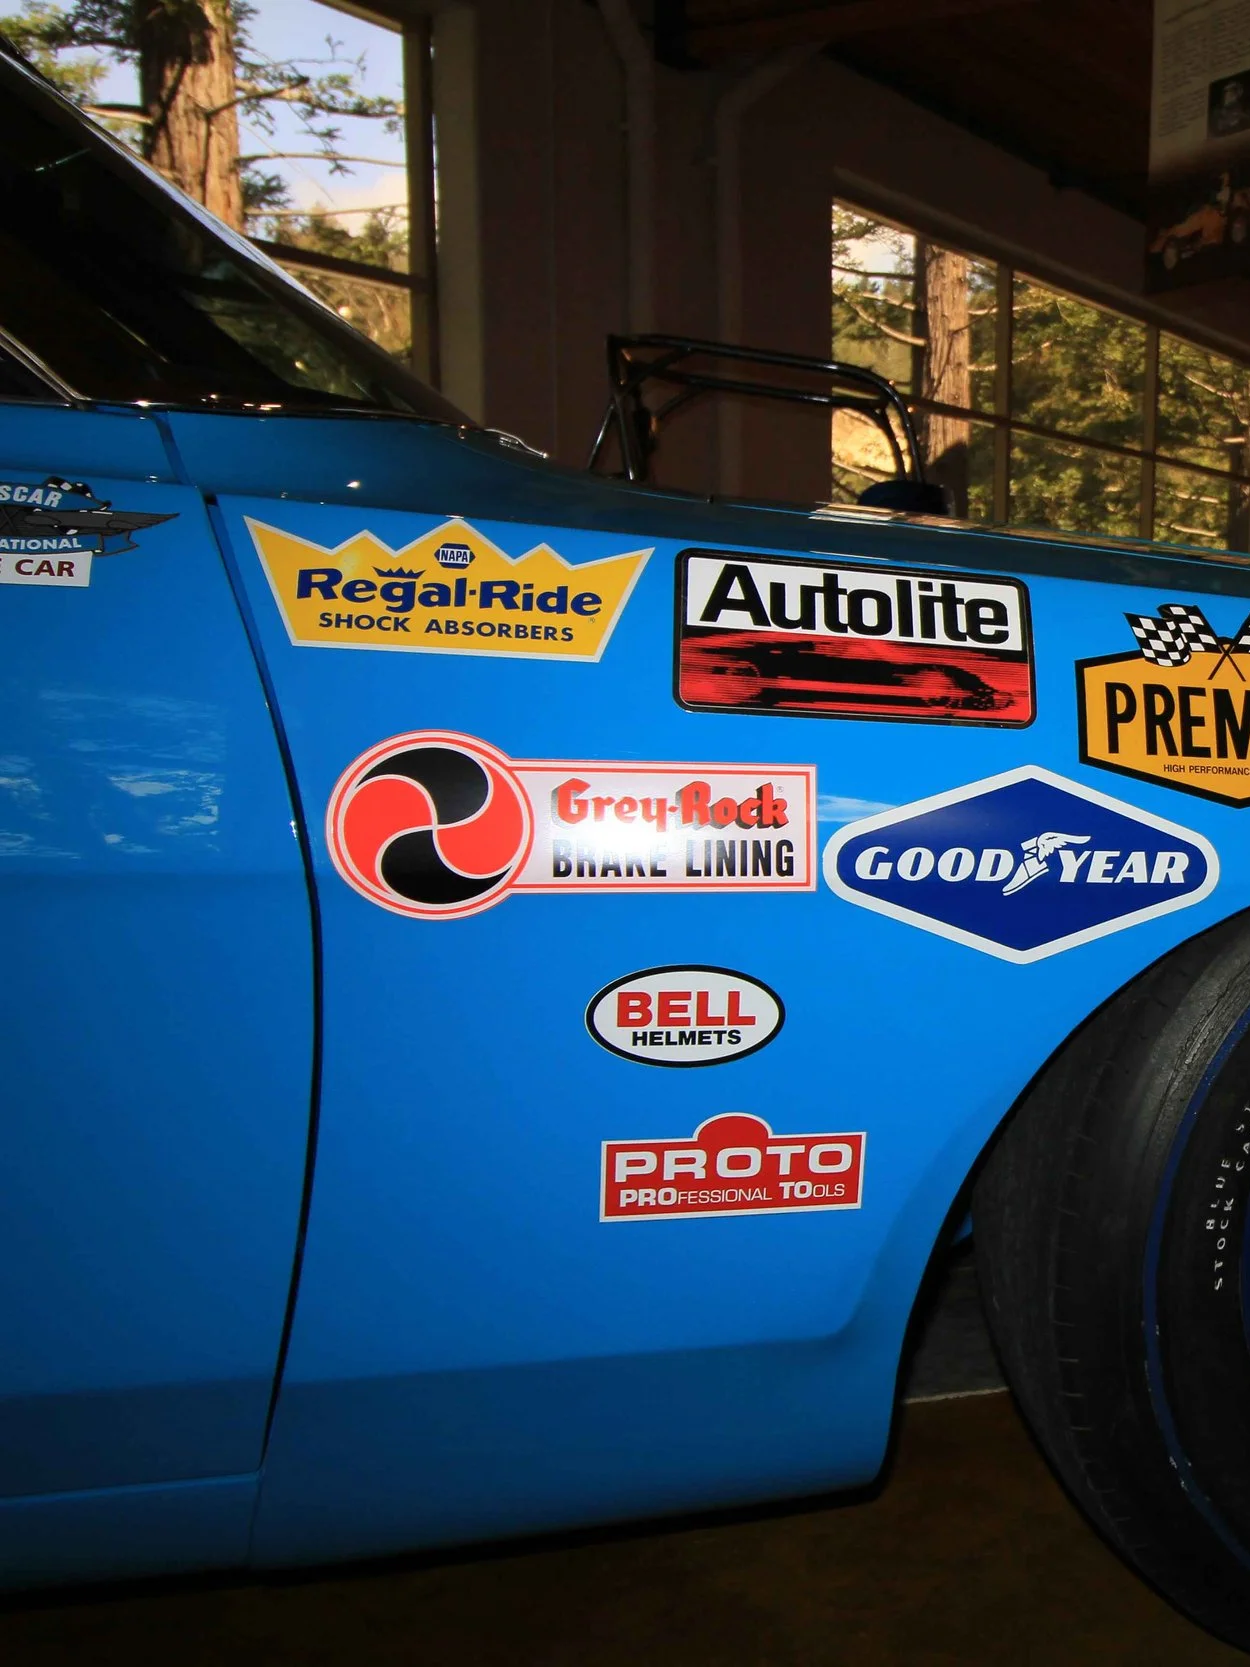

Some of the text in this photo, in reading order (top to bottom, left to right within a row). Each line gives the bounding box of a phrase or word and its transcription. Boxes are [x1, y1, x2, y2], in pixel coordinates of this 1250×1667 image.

[15, 559, 75, 577] CAR
[440, 549, 470, 563] NAPA
[700, 564, 1010, 645] Autolite
[319, 612, 574, 642] SHOCK ABSORBERS
[1163, 764, 1185, 774] HIGH
[552, 777, 790, 832] Grey-Rock
[686, 839, 795, 878] LINING
[616, 990, 756, 1027] BELL
[631, 1029, 742, 1047] HELMETS
[614, 1143, 853, 1183] PROTO
[619, 1180, 845, 1208] PROFESSIONAL TOOLS
[1205, 1158, 1231, 1230] BLUE
[1214, 1198, 1235, 1291] STOCK
